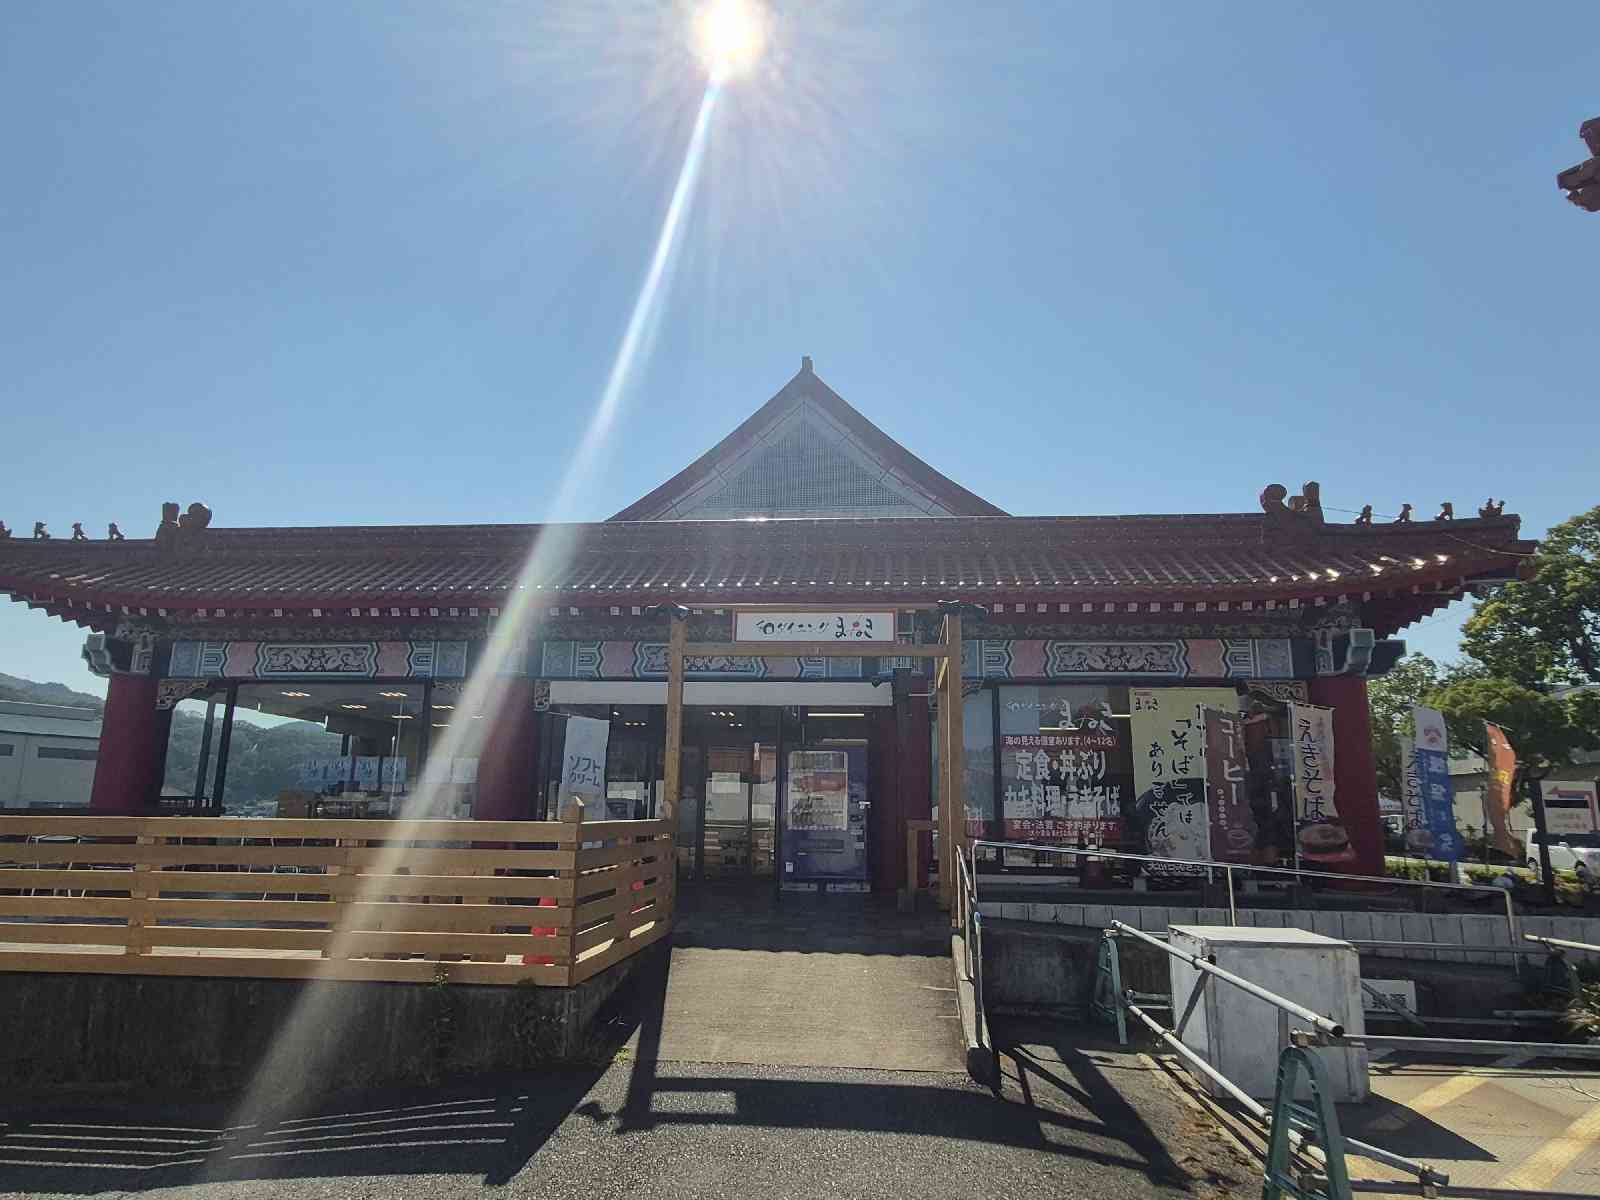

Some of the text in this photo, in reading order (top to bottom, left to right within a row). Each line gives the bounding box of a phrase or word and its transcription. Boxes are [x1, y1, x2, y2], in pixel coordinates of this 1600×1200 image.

[569, 755, 601, 774] ソフト
[1219, 717, 1245, 806] コーヒー
[568, 771, 601, 788] クリーム
